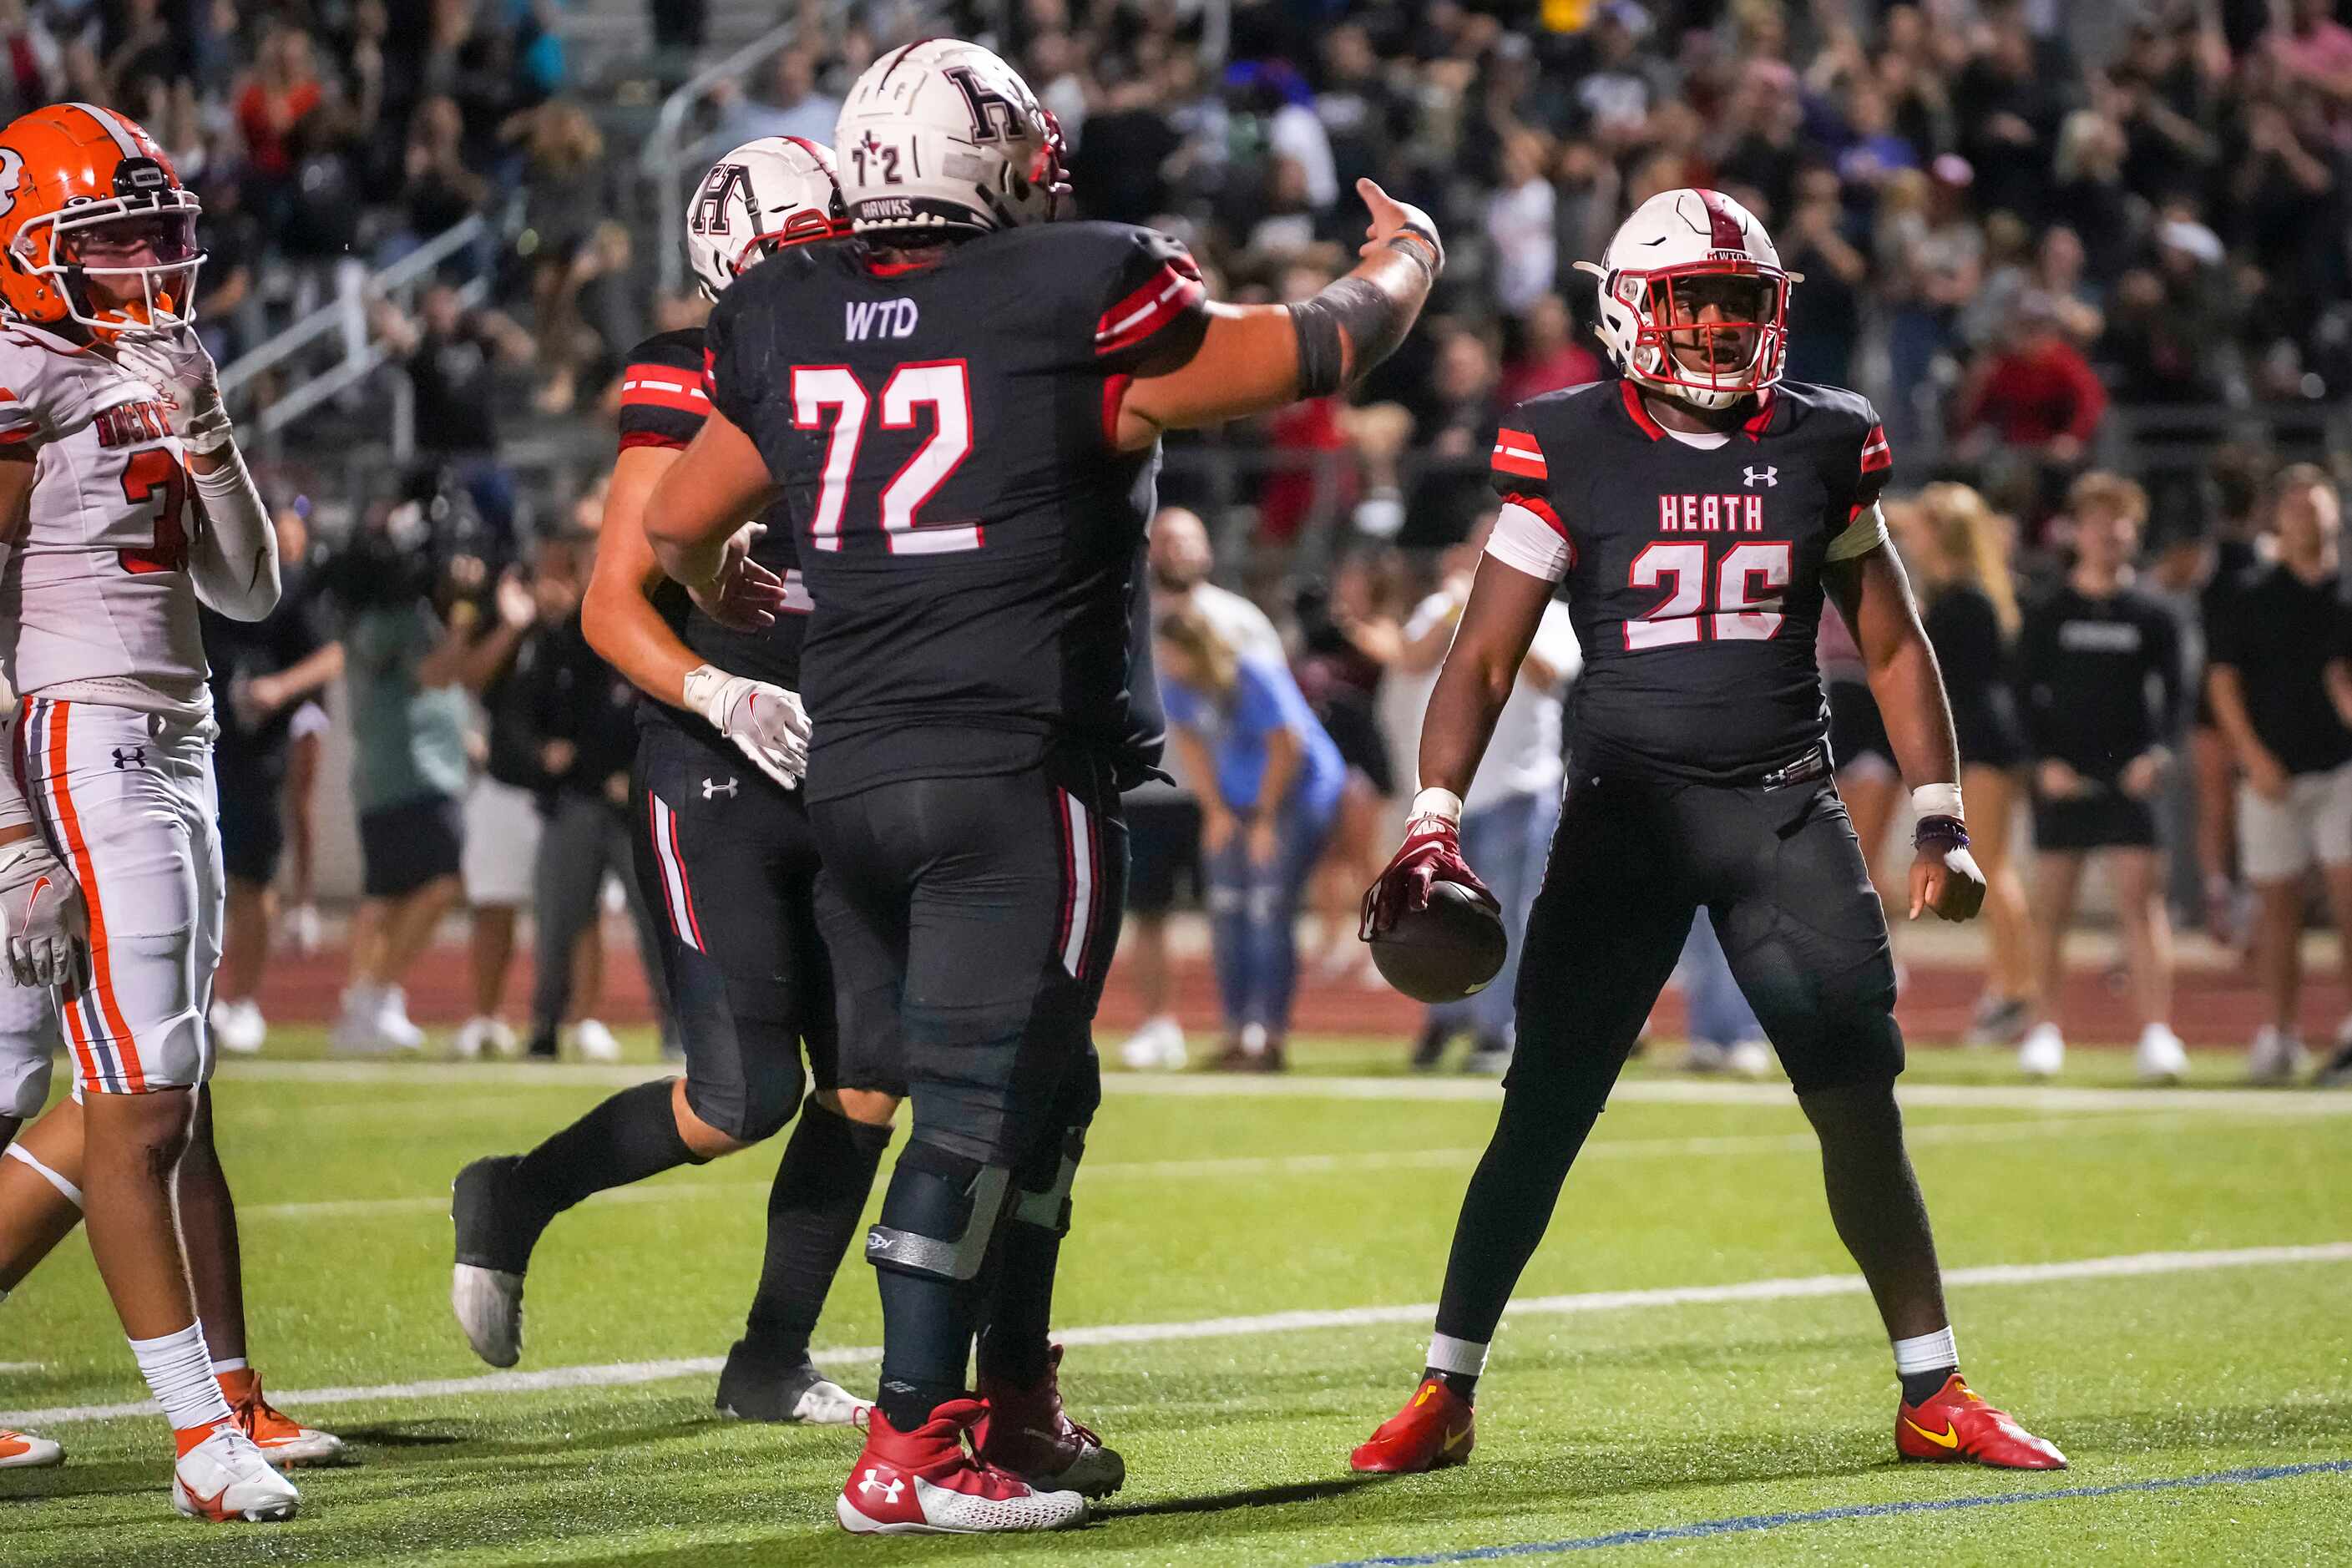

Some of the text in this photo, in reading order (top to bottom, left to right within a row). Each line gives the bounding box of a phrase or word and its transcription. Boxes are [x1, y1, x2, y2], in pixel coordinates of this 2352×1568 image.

[941, 66, 1027, 144] H
[851, 146, 903, 186] 72
[691, 164, 741, 235] H
[861, 200, 913, 218] HAWKS
[846, 297, 918, 341] WTD
[790, 357, 985, 556] 72
[1658, 493, 1763, 532] HEATH
[1622, 540, 1793, 651] 26
